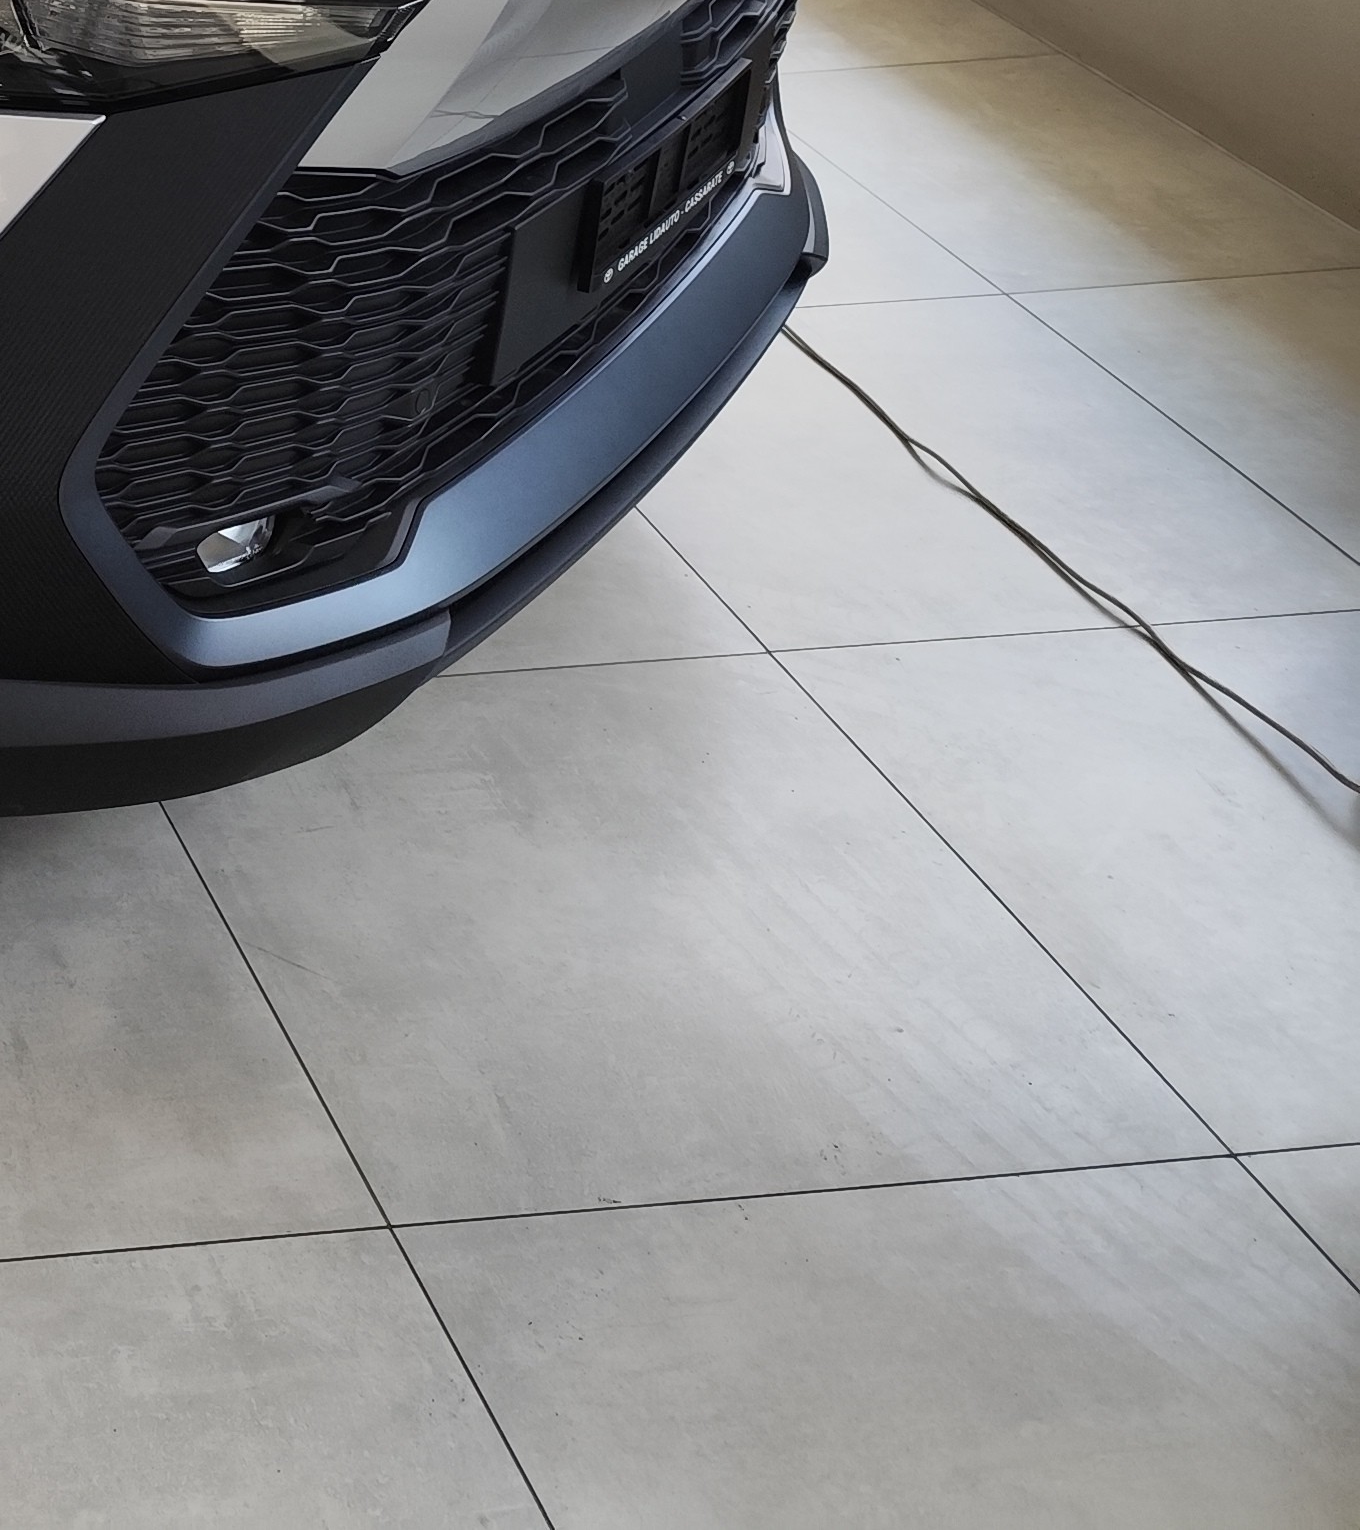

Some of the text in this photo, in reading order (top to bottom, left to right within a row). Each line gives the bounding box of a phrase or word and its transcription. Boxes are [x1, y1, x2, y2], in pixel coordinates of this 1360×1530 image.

[617, 236, 649, 272] GARAGE
[649, 209, 681, 245] LIDAUTO
[684, 170, 724, 213] CASSARATE
